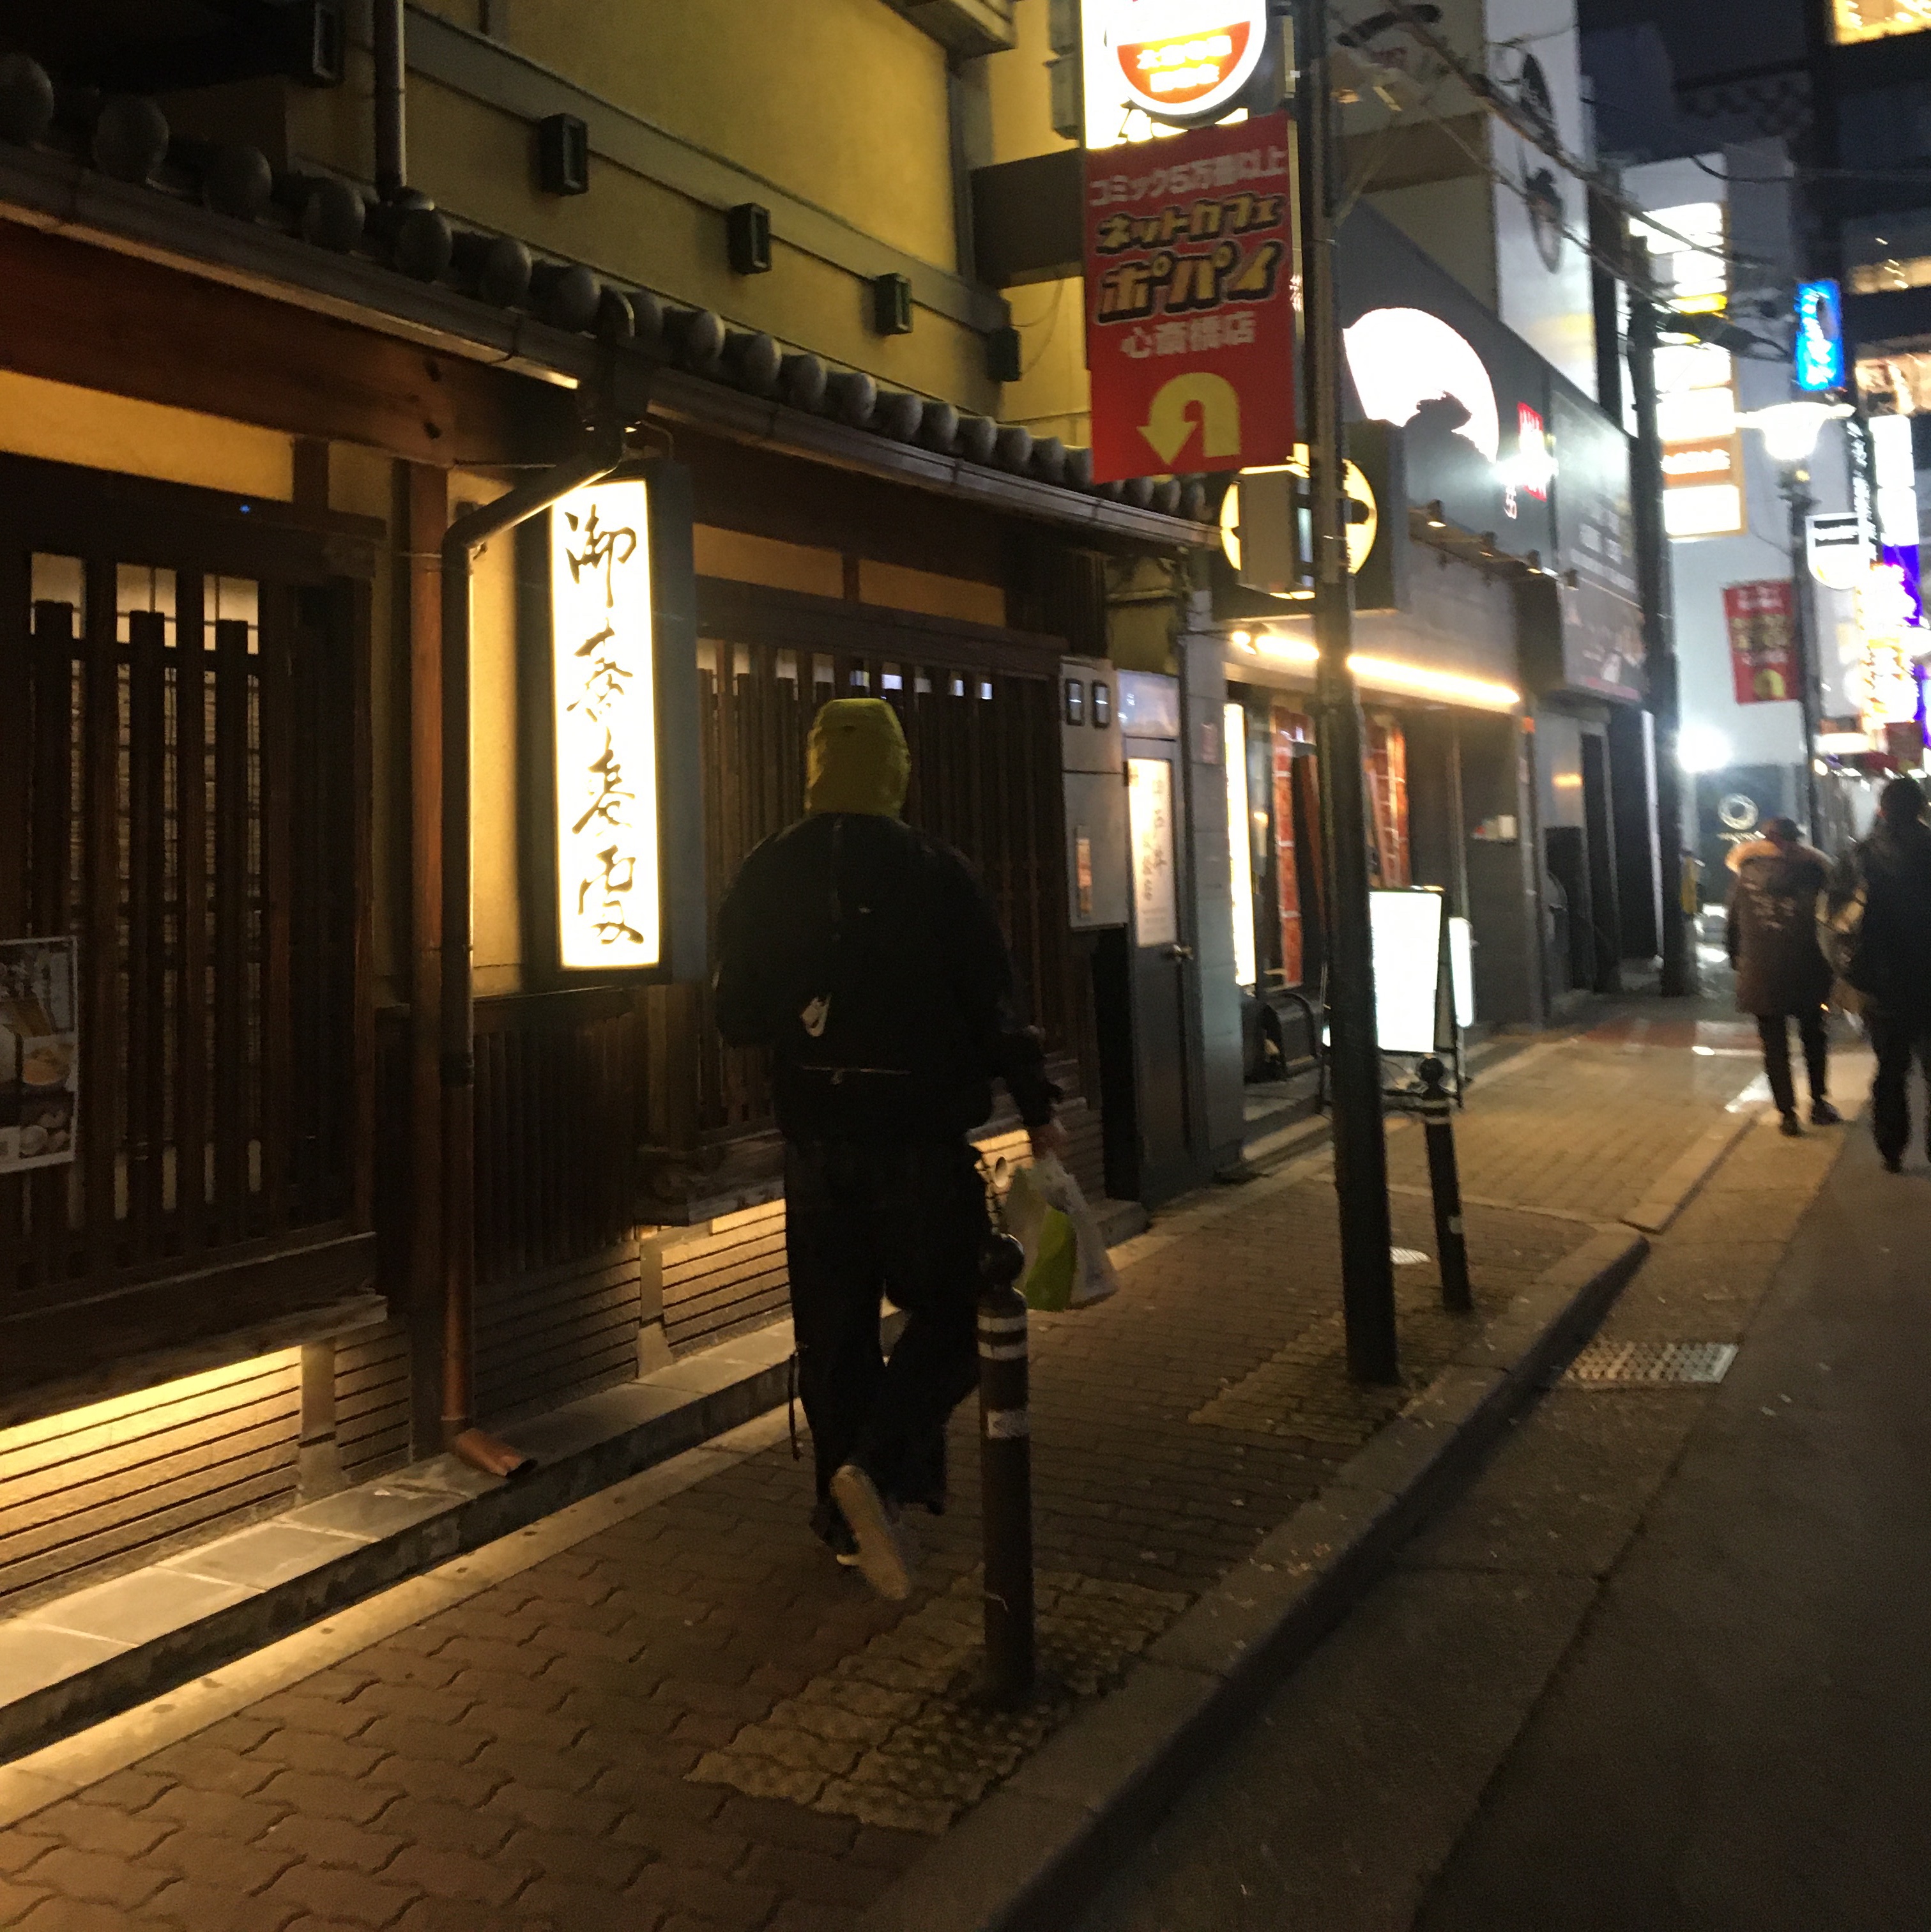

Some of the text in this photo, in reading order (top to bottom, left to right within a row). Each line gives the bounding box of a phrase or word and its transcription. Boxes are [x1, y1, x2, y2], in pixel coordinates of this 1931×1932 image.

[1098, 194, 1285, 253] ネットカフェ
[1099, 242, 1283, 321] ポパイ
